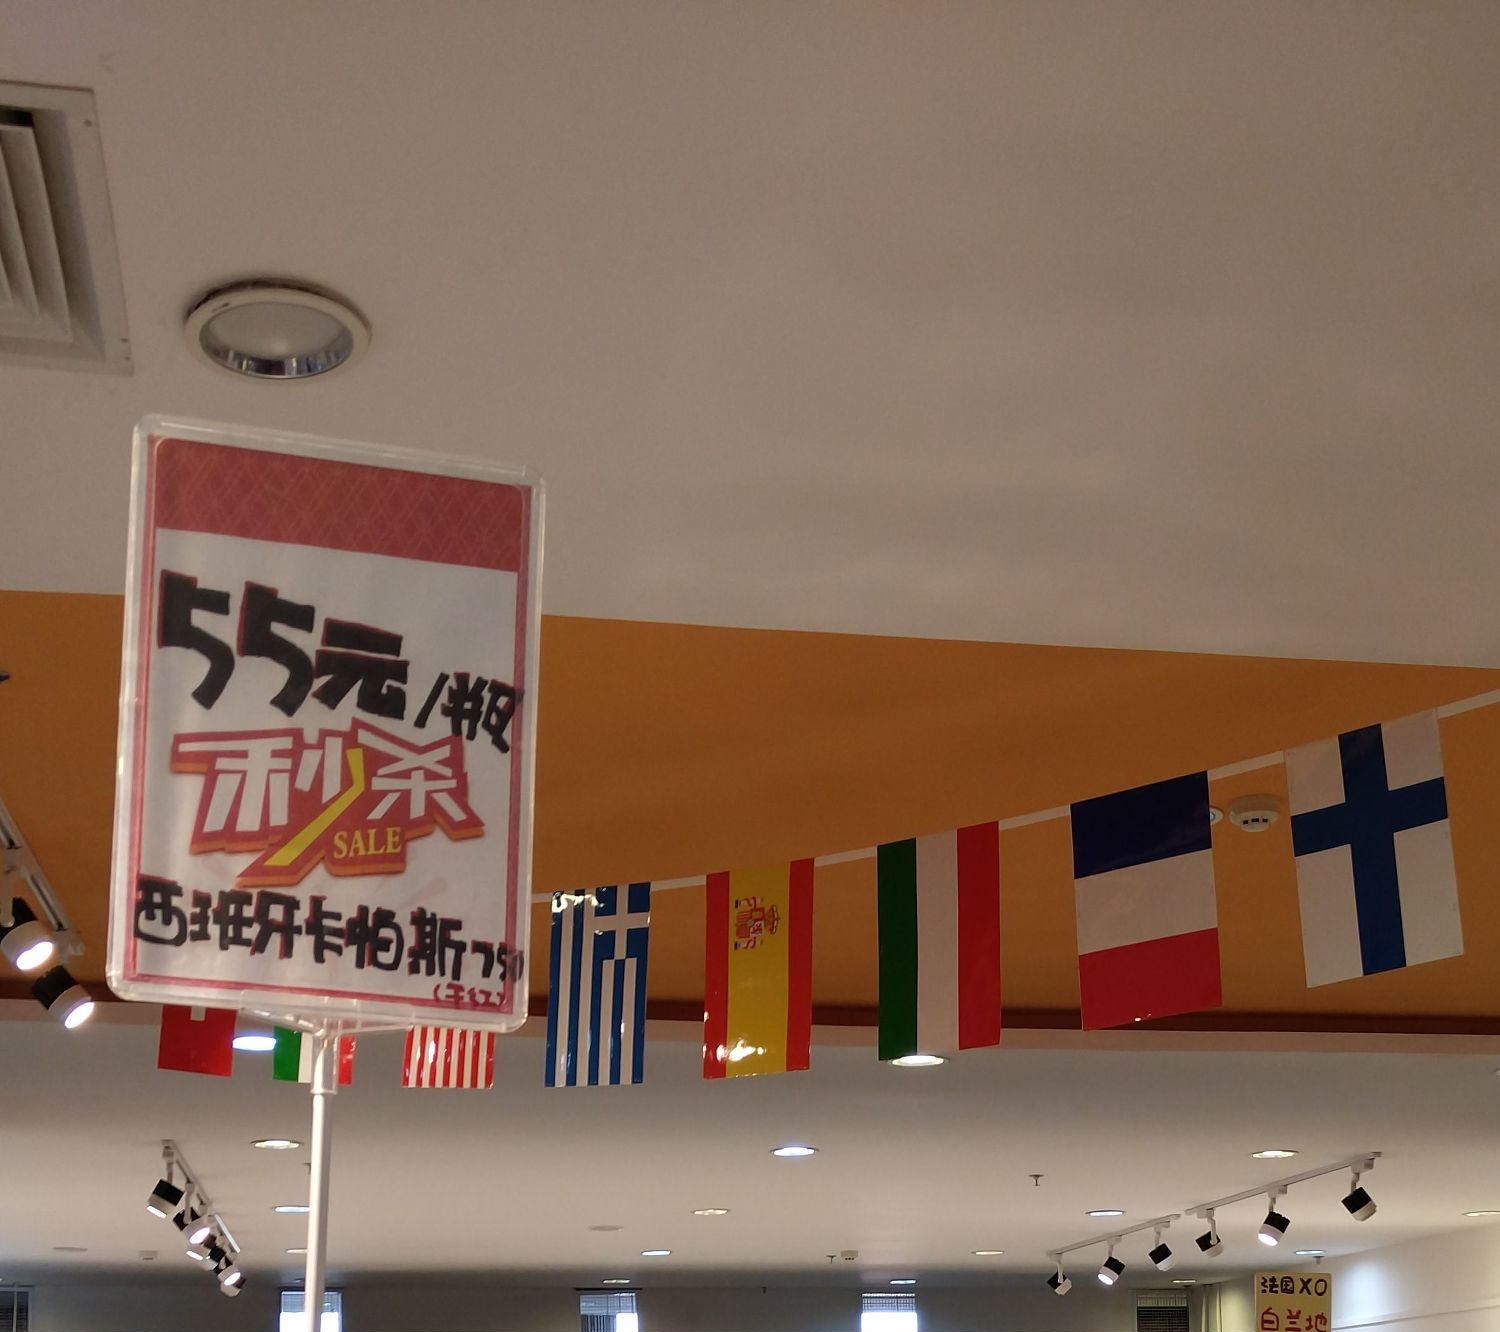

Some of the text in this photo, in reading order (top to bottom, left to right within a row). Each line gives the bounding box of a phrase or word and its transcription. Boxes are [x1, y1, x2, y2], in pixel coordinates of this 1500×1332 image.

[333, 826, 402, 859] SALE
[1261, 1307, 1328, 1332] 白兰地
